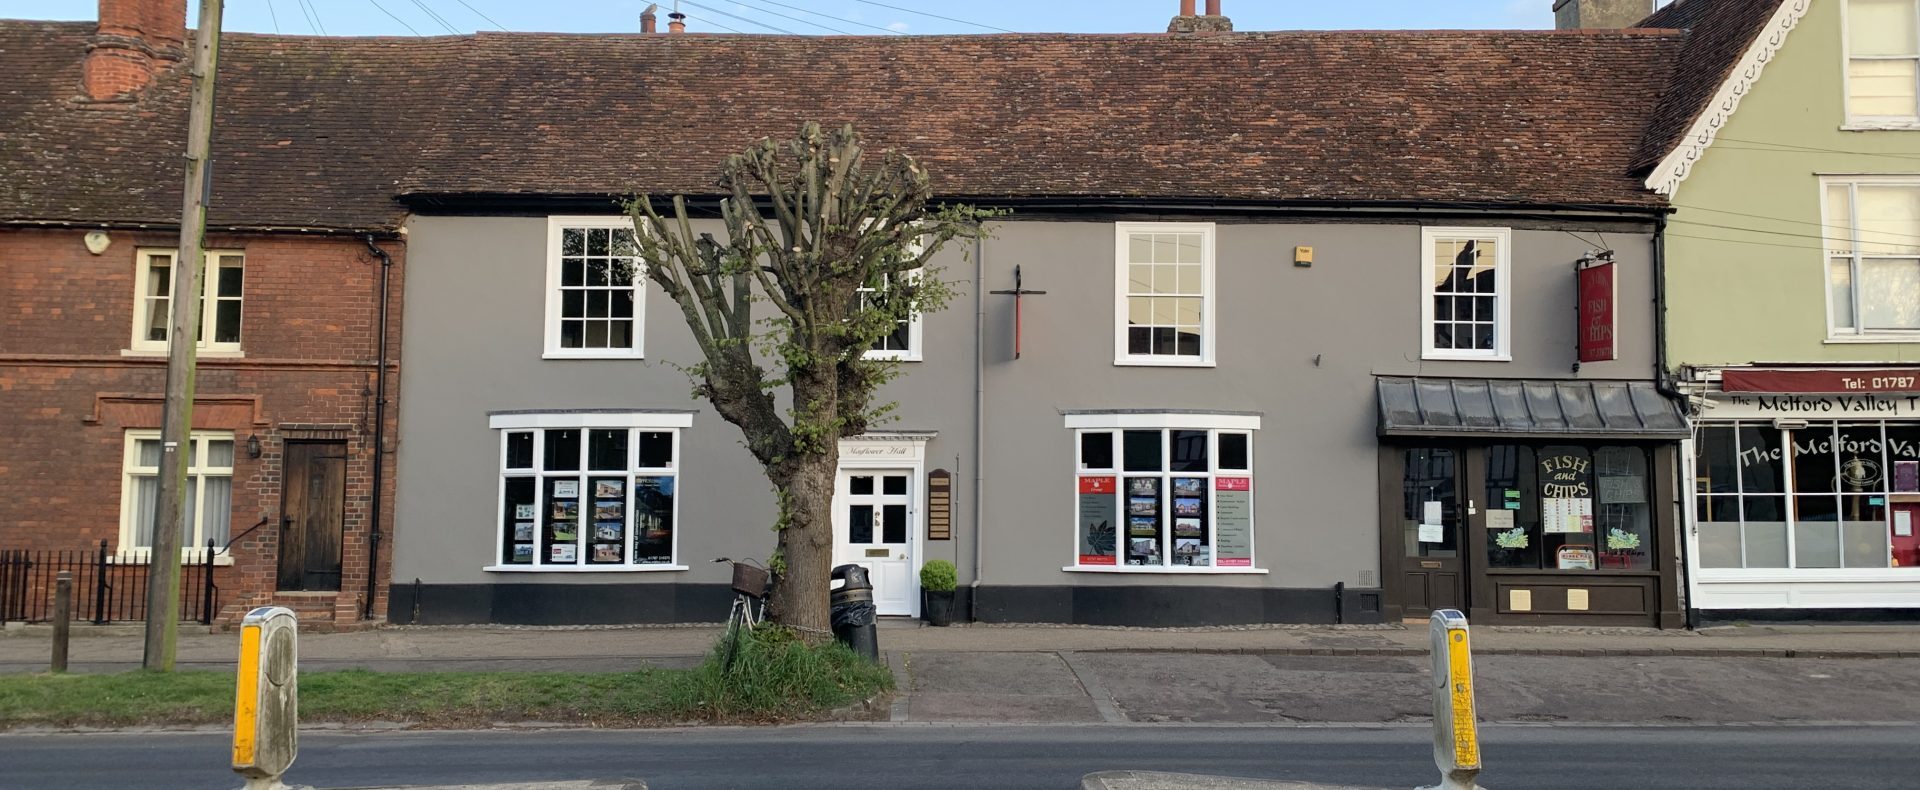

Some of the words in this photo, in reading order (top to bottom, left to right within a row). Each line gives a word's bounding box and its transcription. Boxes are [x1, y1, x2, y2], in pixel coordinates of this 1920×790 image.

[1588, 299, 1607, 314] FISH
[1583, 325, 1612, 342] CHIPS
[1842, 378, 1866, 389] Tel:
[1872, 376, 1915, 389] 01787
[1731, 395, 1750, 406] The
[1758, 395, 1833, 412] Melford
[1836, 394, 1898, 416] Valley
[847, 447, 883, 455] Mayflower
[886, 446, 907, 455] Hall
[1740, 446, 1782, 468] The
[1793, 434, 1882, 458] Melford
[1541, 455, 1589, 474] FISH
[1554, 471, 1577, 481] and
[1543, 481, 1589, 498] CHIPS
